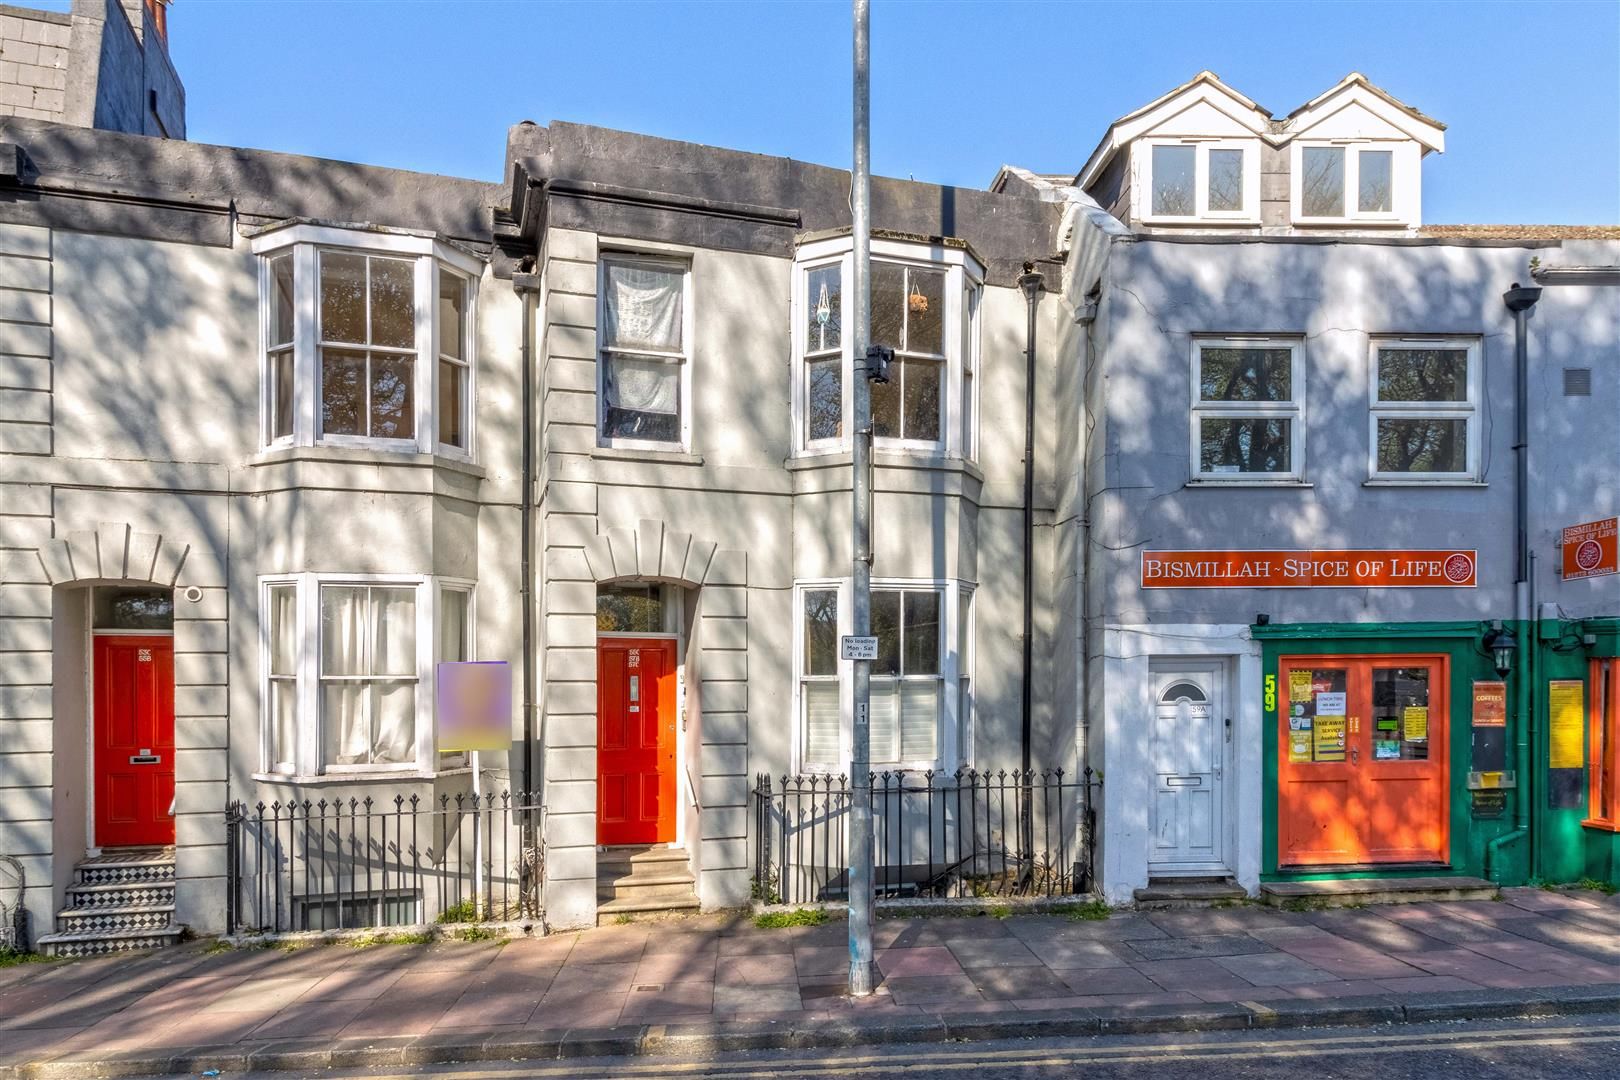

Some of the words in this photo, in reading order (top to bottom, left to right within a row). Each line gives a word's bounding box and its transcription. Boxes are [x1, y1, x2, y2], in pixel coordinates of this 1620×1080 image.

[1145, 559, 1271, 578] BISMILLAH
[1283, 559, 1349, 577] SPICE
[1355, 561, 1384, 577] OF
[1389, 559, 1442, 577] LIFE
[1265, 674, 1275, 712] 59
